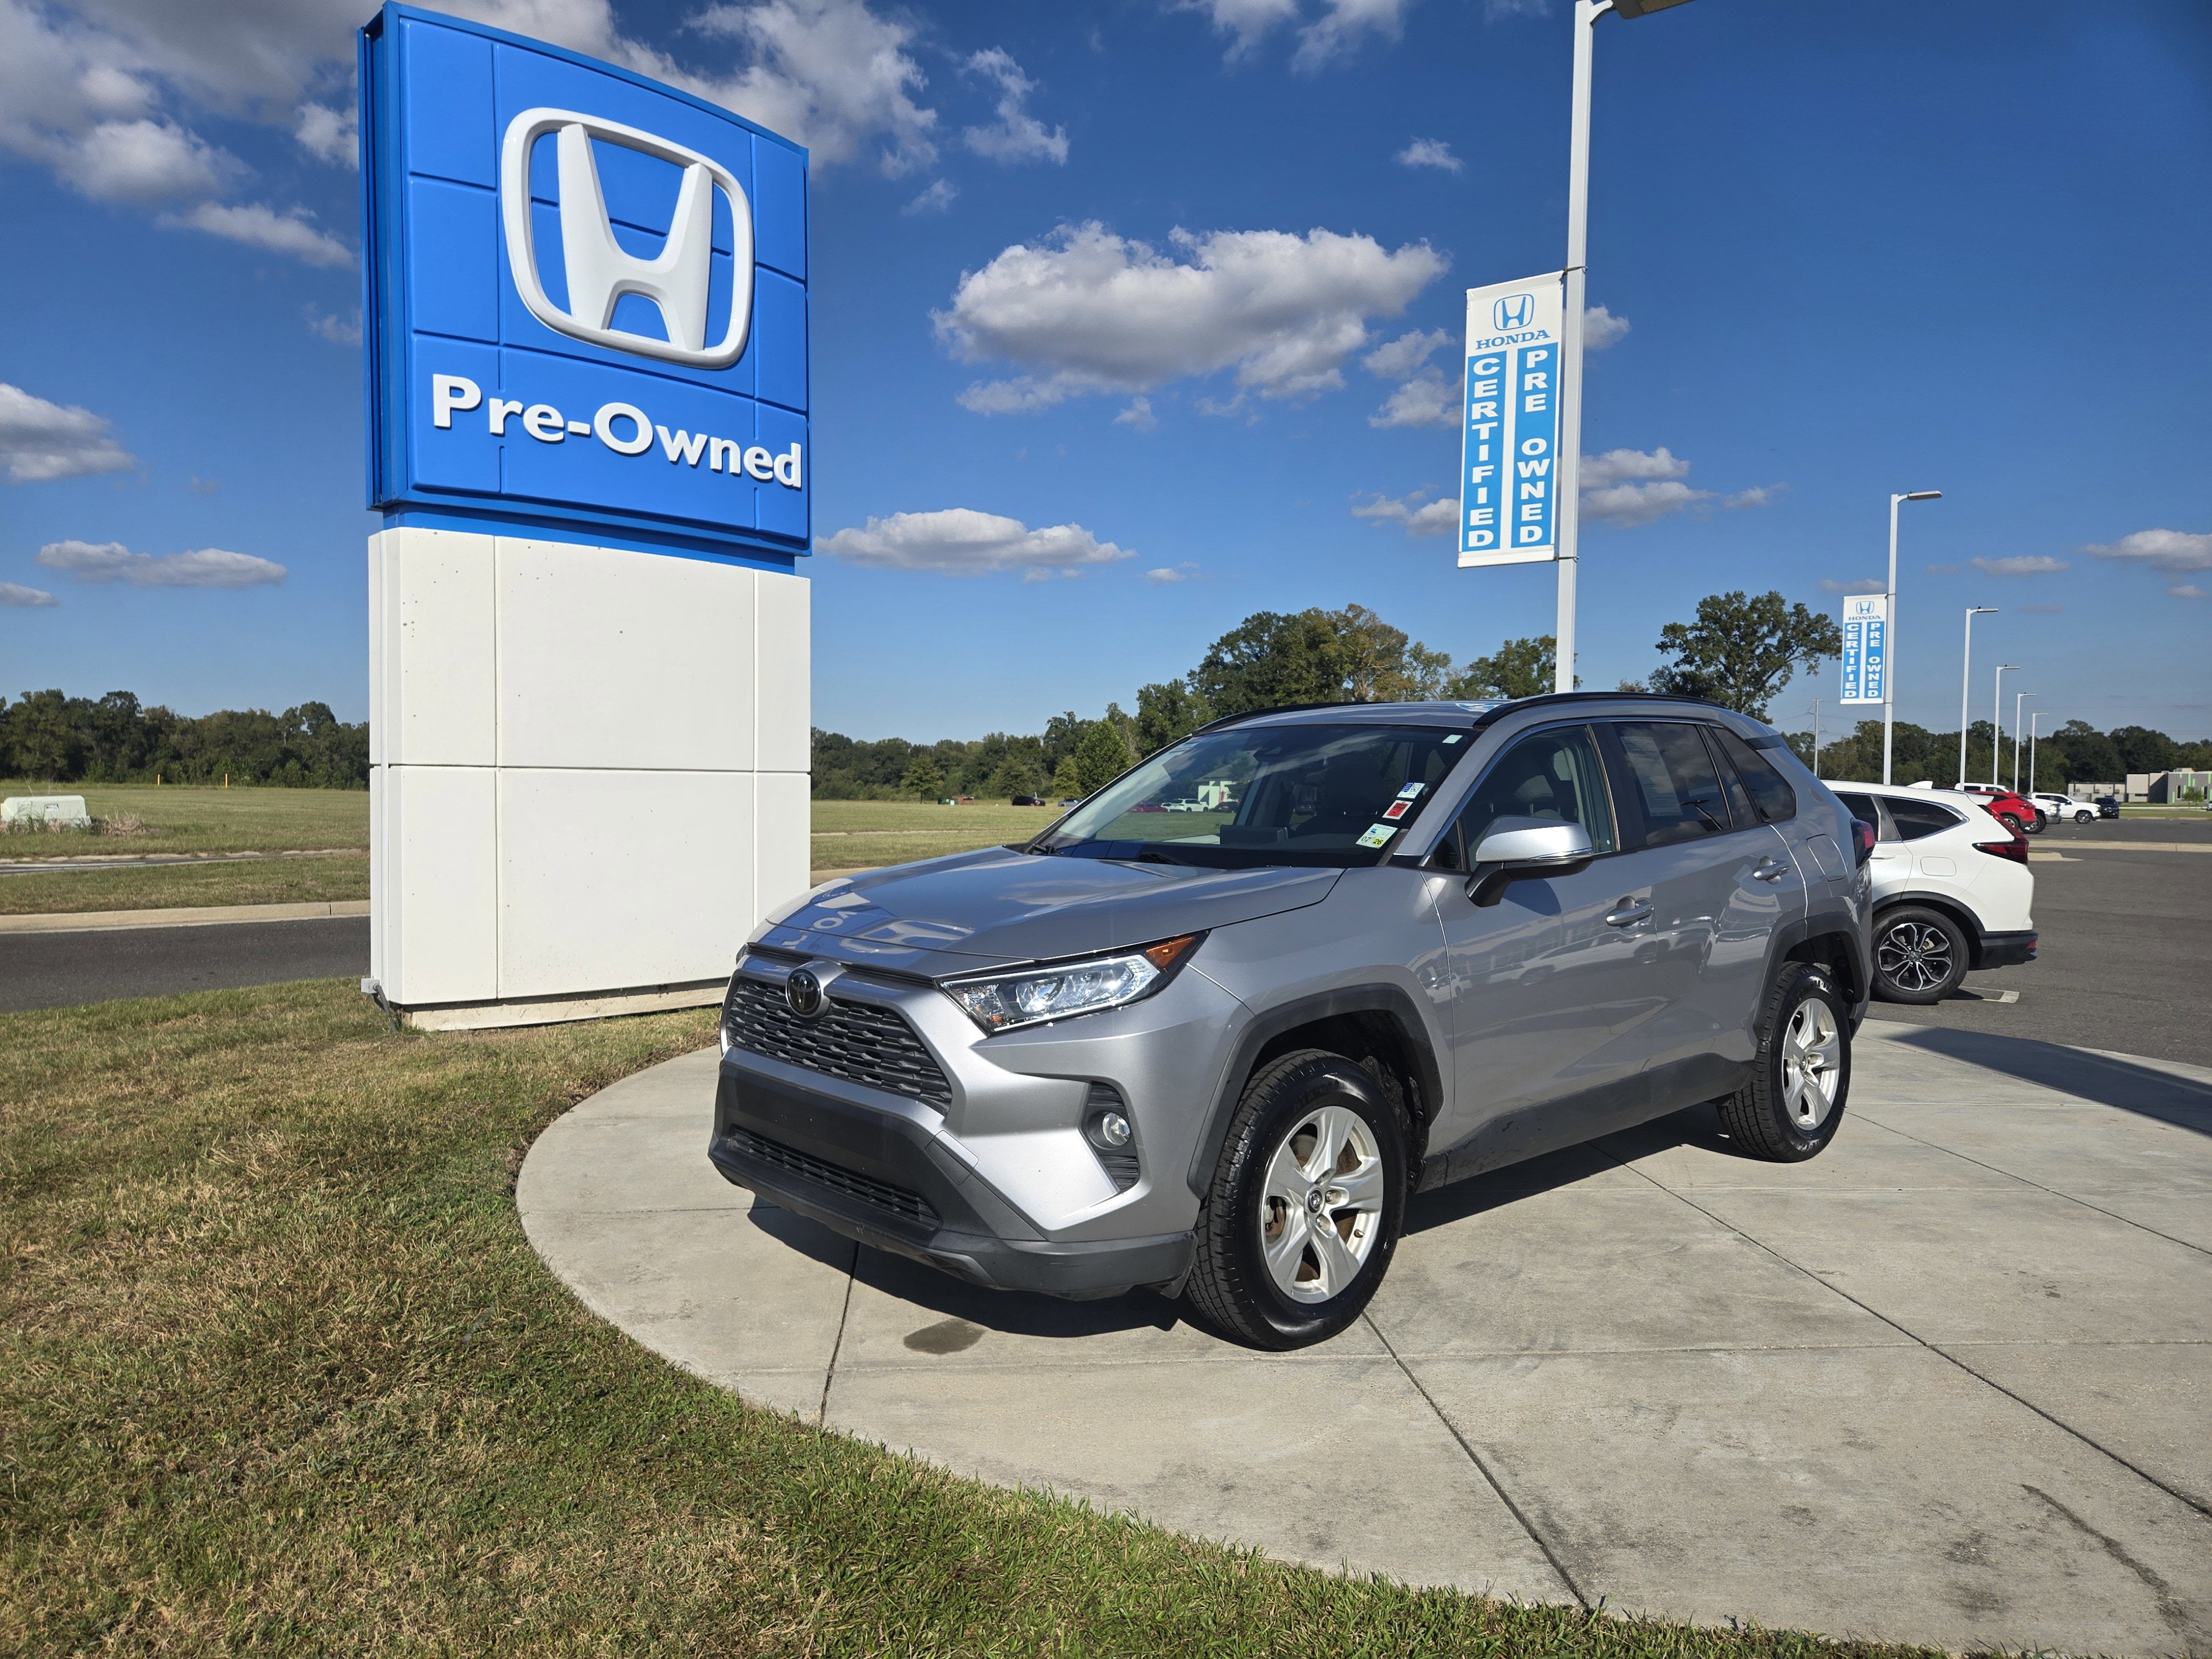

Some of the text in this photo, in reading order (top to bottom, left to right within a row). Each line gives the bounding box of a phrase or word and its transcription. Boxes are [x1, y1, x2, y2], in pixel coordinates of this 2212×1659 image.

[1475, 330, 1550, 349] HONDA
[432, 374, 801, 488] Pre-Owned
[1468, 357, 1500, 547] CERTIFIED
[1517, 349, 1550, 543] PRE OWNED
[1845, 624, 1859, 697] CERTIFIED
[1867, 623, 1881, 697] PRE OWNED
